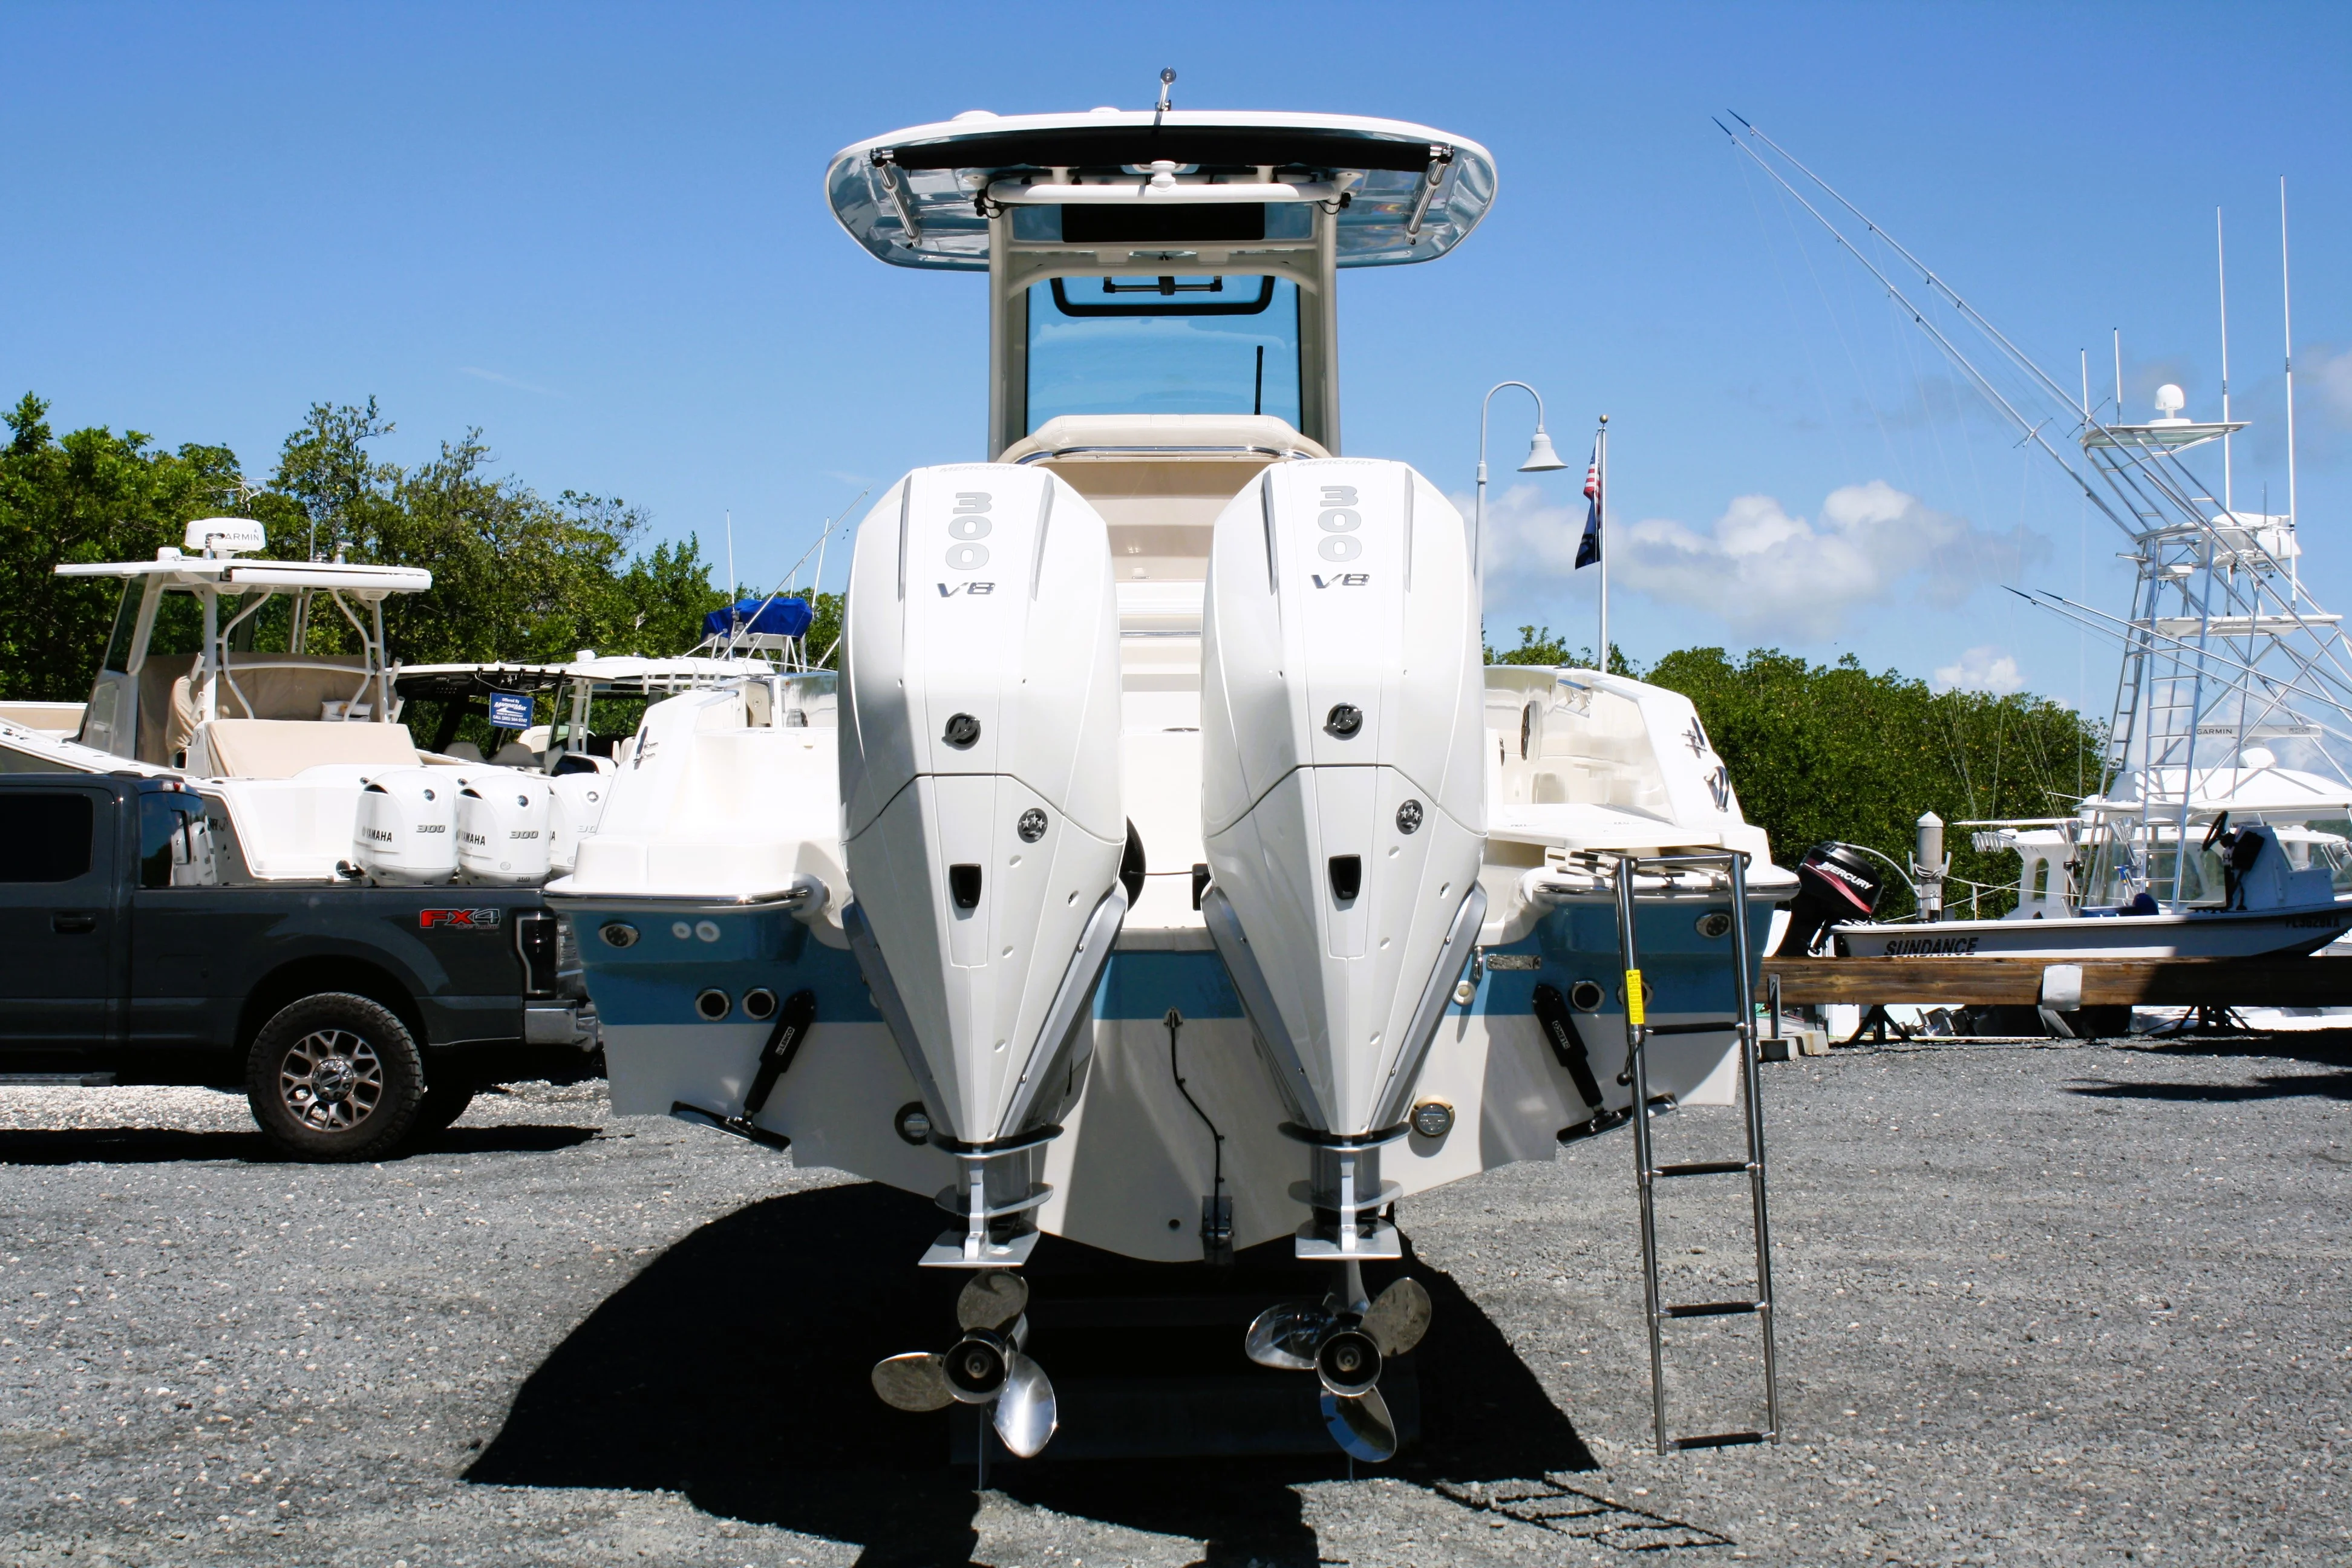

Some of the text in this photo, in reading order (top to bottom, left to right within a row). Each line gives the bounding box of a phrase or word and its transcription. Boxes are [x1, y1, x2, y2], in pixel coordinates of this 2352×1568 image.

[945, 492, 992, 570] 300
[1318, 485, 1362, 562] 300
[219, 532, 260, 541] ARMIN
[1310, 573, 1370, 589] V8
[936, 582, 996, 598] V8
[366, 828, 393, 843] YAMAHA
[416, 825, 446, 833] 300
[509, 830, 538, 838] 300
[462, 830, 485, 846] YAMAHA
[1815, 861, 1873, 889] MERCURY
[419, 908, 500, 929] FX4
[1884, 938, 1979, 958] SUNDANCE
